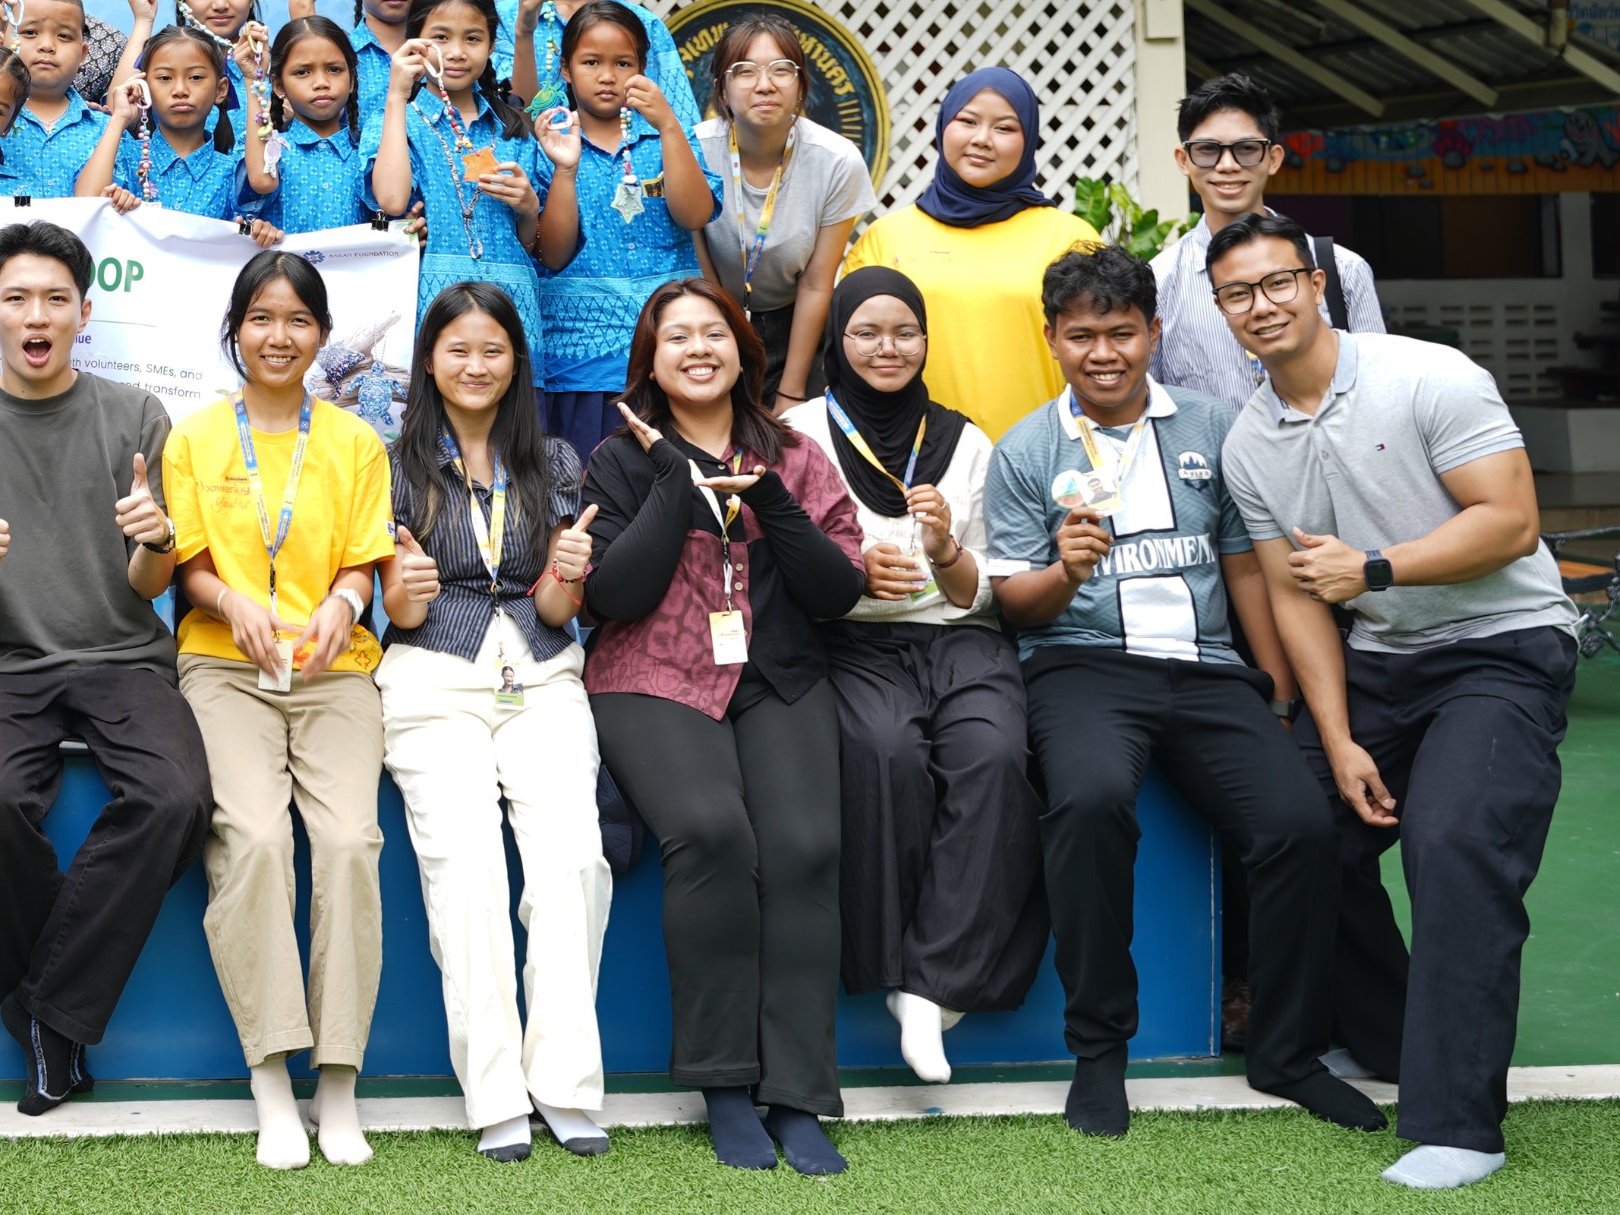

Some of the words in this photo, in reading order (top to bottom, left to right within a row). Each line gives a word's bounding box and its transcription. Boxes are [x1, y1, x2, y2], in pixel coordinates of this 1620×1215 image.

[354, 250, 399, 258] FOUNDATION
[84, 358, 142, 373] volunteers,
[146, 363, 177, 378] SMEs,
[180, 369, 203, 381] and
[144, 383, 201, 399] transform
